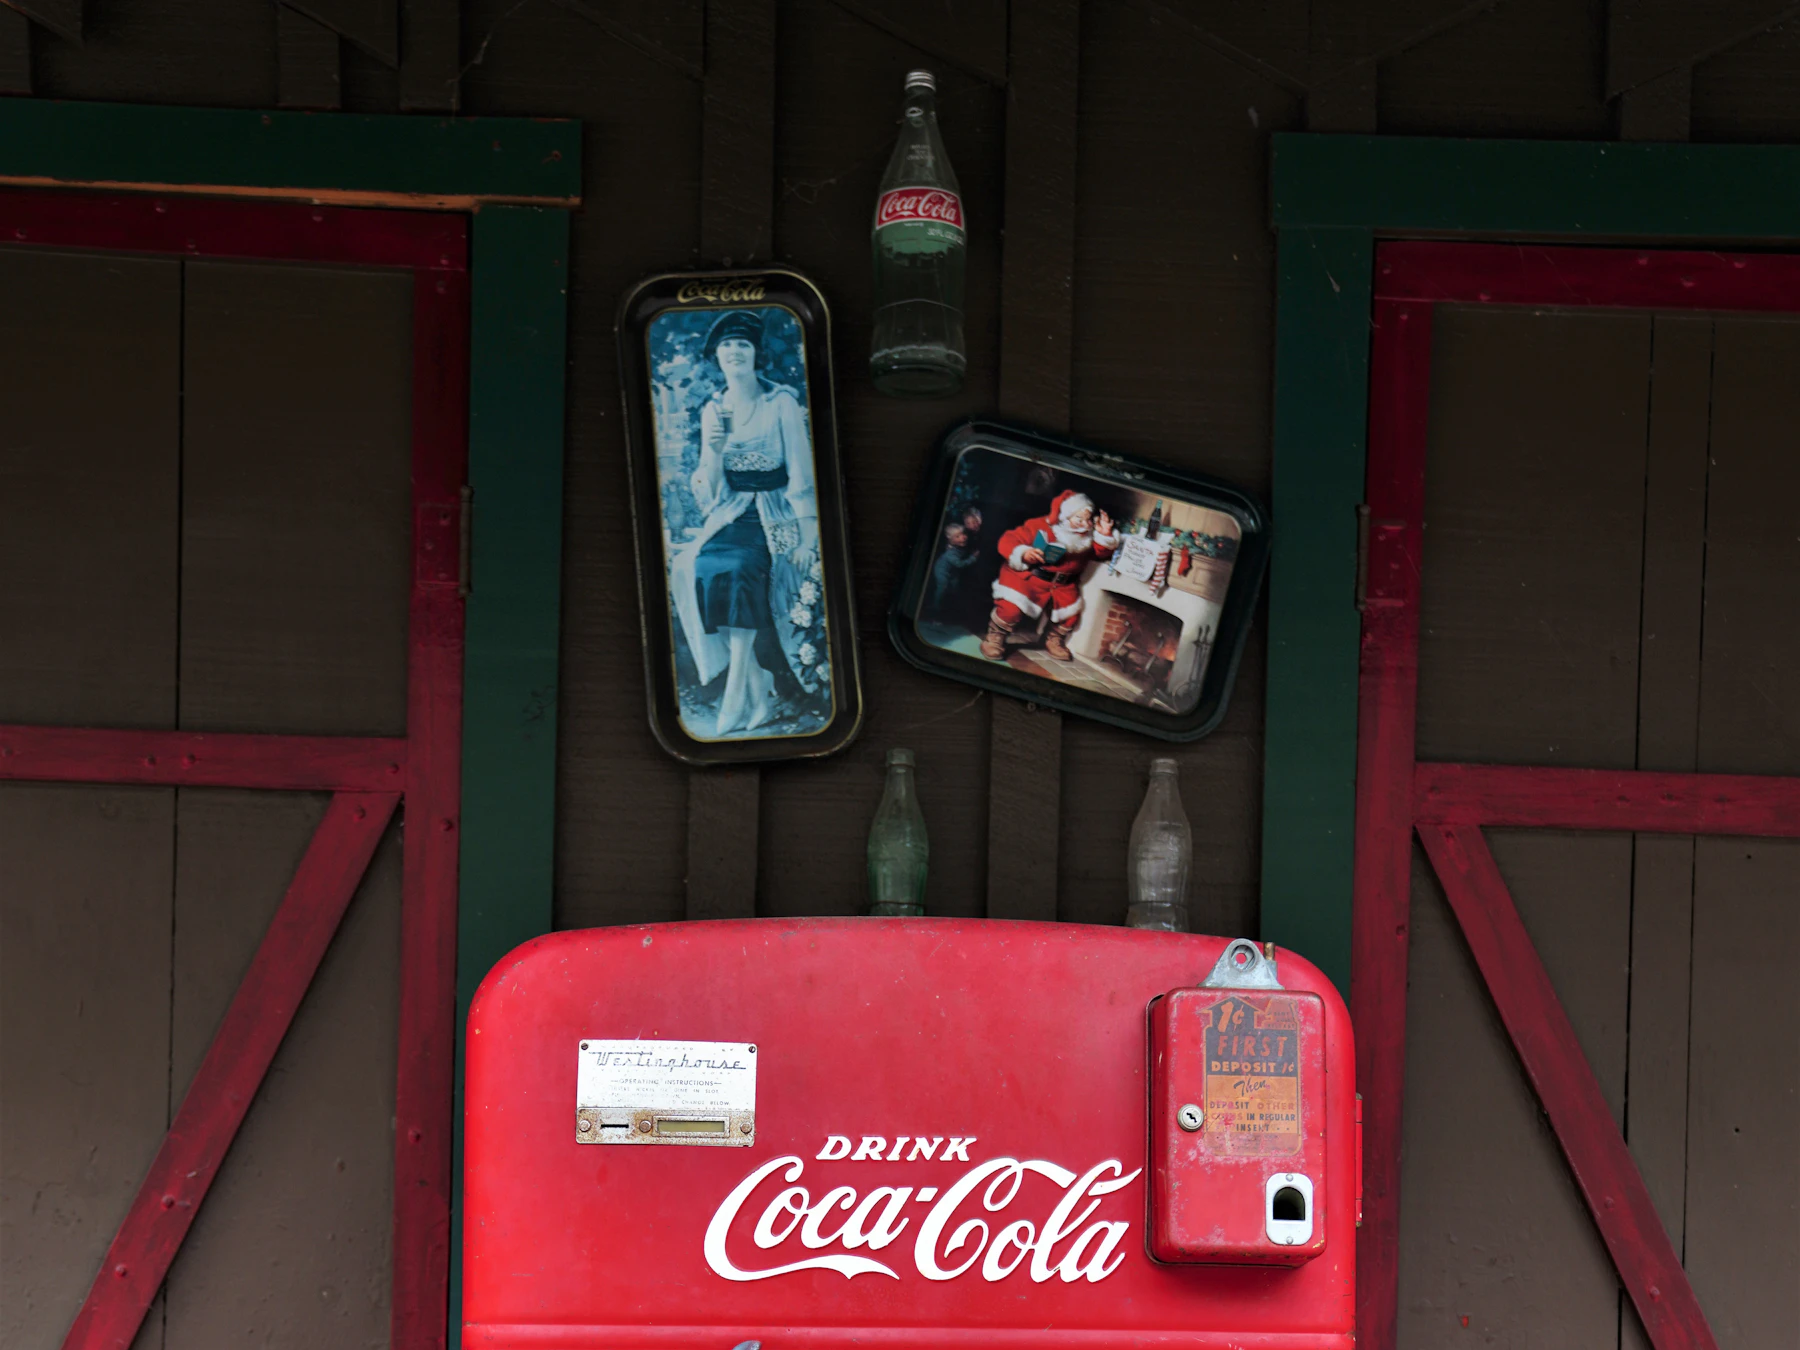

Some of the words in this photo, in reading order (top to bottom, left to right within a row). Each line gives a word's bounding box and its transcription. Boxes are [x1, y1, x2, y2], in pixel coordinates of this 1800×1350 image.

[880, 191, 957, 222] Coca-Cola
[1217, 1035, 1288, 1057] FIRST
[588, 1051, 747, 1072] Westinghouse
[1211, 1061, 1276, 1072] DEPOSIT
[1209, 1101, 1249, 1110] DEPOSIT
[1257, 1102, 1295, 1111] OTHER
[1246, 1113, 1255, 1121] IN
[1259, 1113, 1296, 1122] REGULAR
[815, 1135, 978, 1162] DRINK
[703, 1154, 1143, 1284] Coca-Cola
